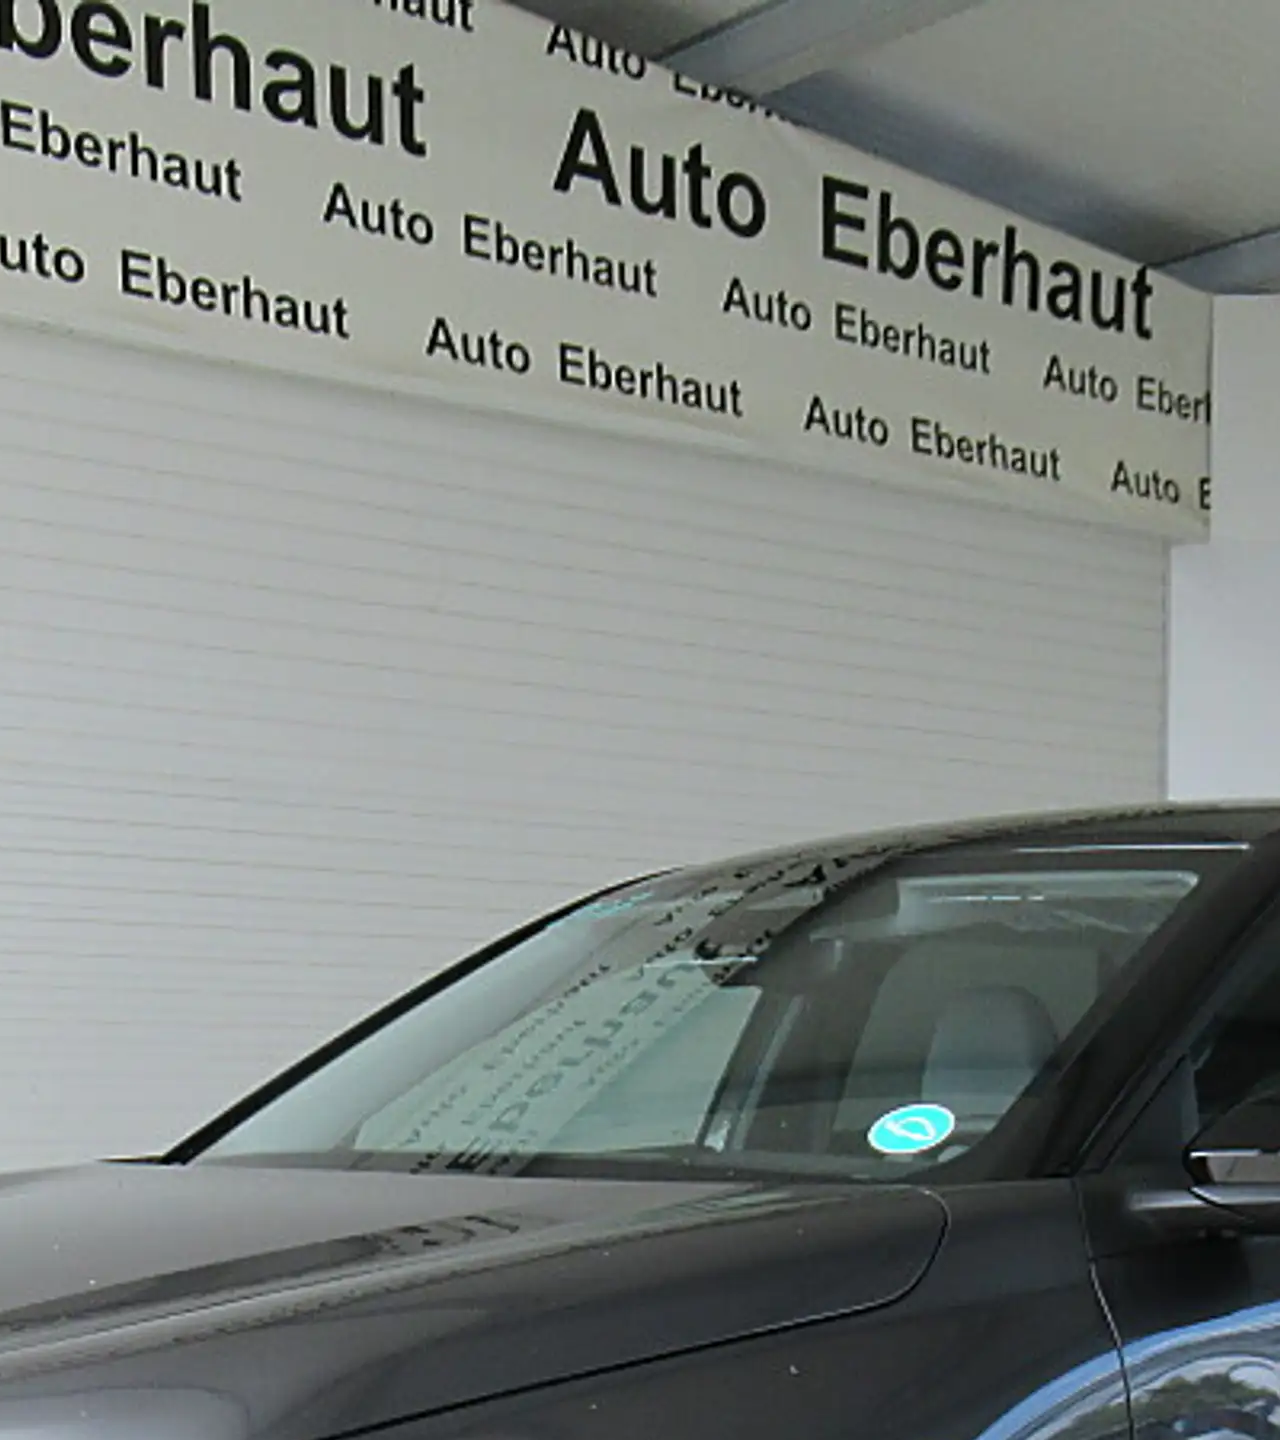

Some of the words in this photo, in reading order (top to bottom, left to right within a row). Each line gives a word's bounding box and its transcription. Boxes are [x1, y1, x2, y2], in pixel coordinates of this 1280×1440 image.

[0, 100, 242, 202] Eberhaut
[323, 182, 434, 245] Auto
[464, 213, 658, 298] Eberhaut
[553, 107, 767, 240] Auto
[822, 175, 1153, 340] Eberhaut
[120, 248, 350, 340] Eberhaut
[722, 276, 812, 331] Auto
[835, 303, 991, 375] Eberhaut
[425, 316, 531, 375] Auto
[559, 342, 743, 418] Eberhaut
[1043, 354, 1118, 402] Auto
[804, 395, 890, 446] Auto
[911, 416, 1061, 481] Eberhaut
[1110, 460, 1181, 505] Auto
